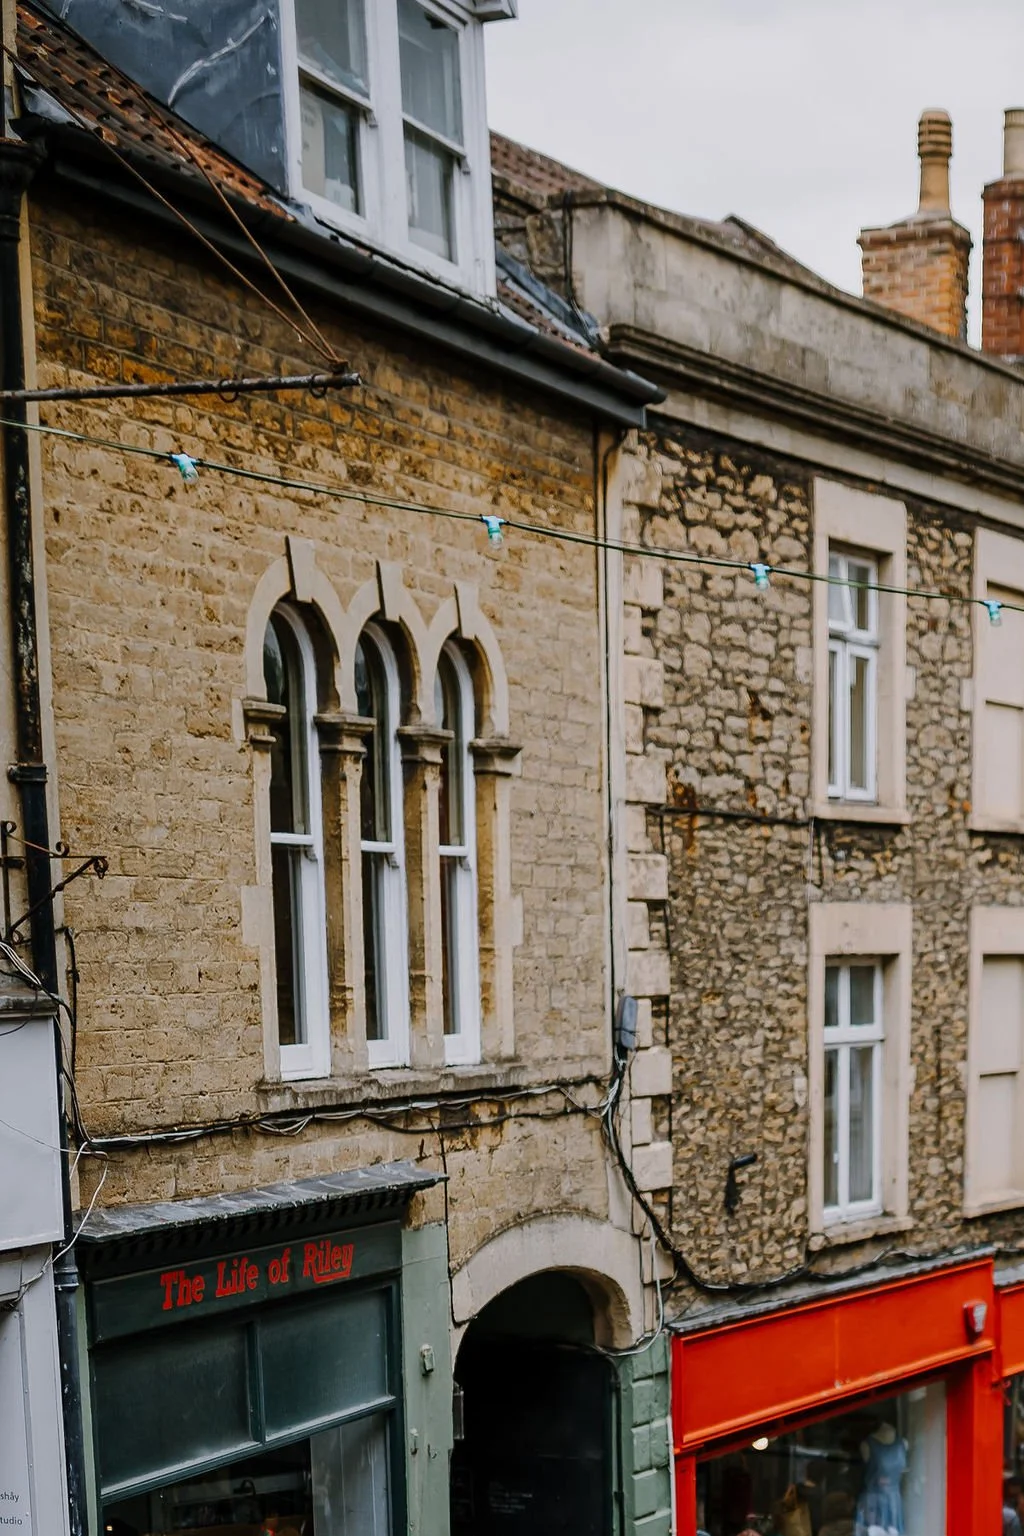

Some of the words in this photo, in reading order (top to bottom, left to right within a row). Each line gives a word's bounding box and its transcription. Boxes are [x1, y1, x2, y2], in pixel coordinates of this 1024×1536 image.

[160, 1269, 205, 1311] The
[215, 1257, 259, 1298] Life
[268, 1248, 291, 1285] of
[303, 1240, 354, 1284] Riley
